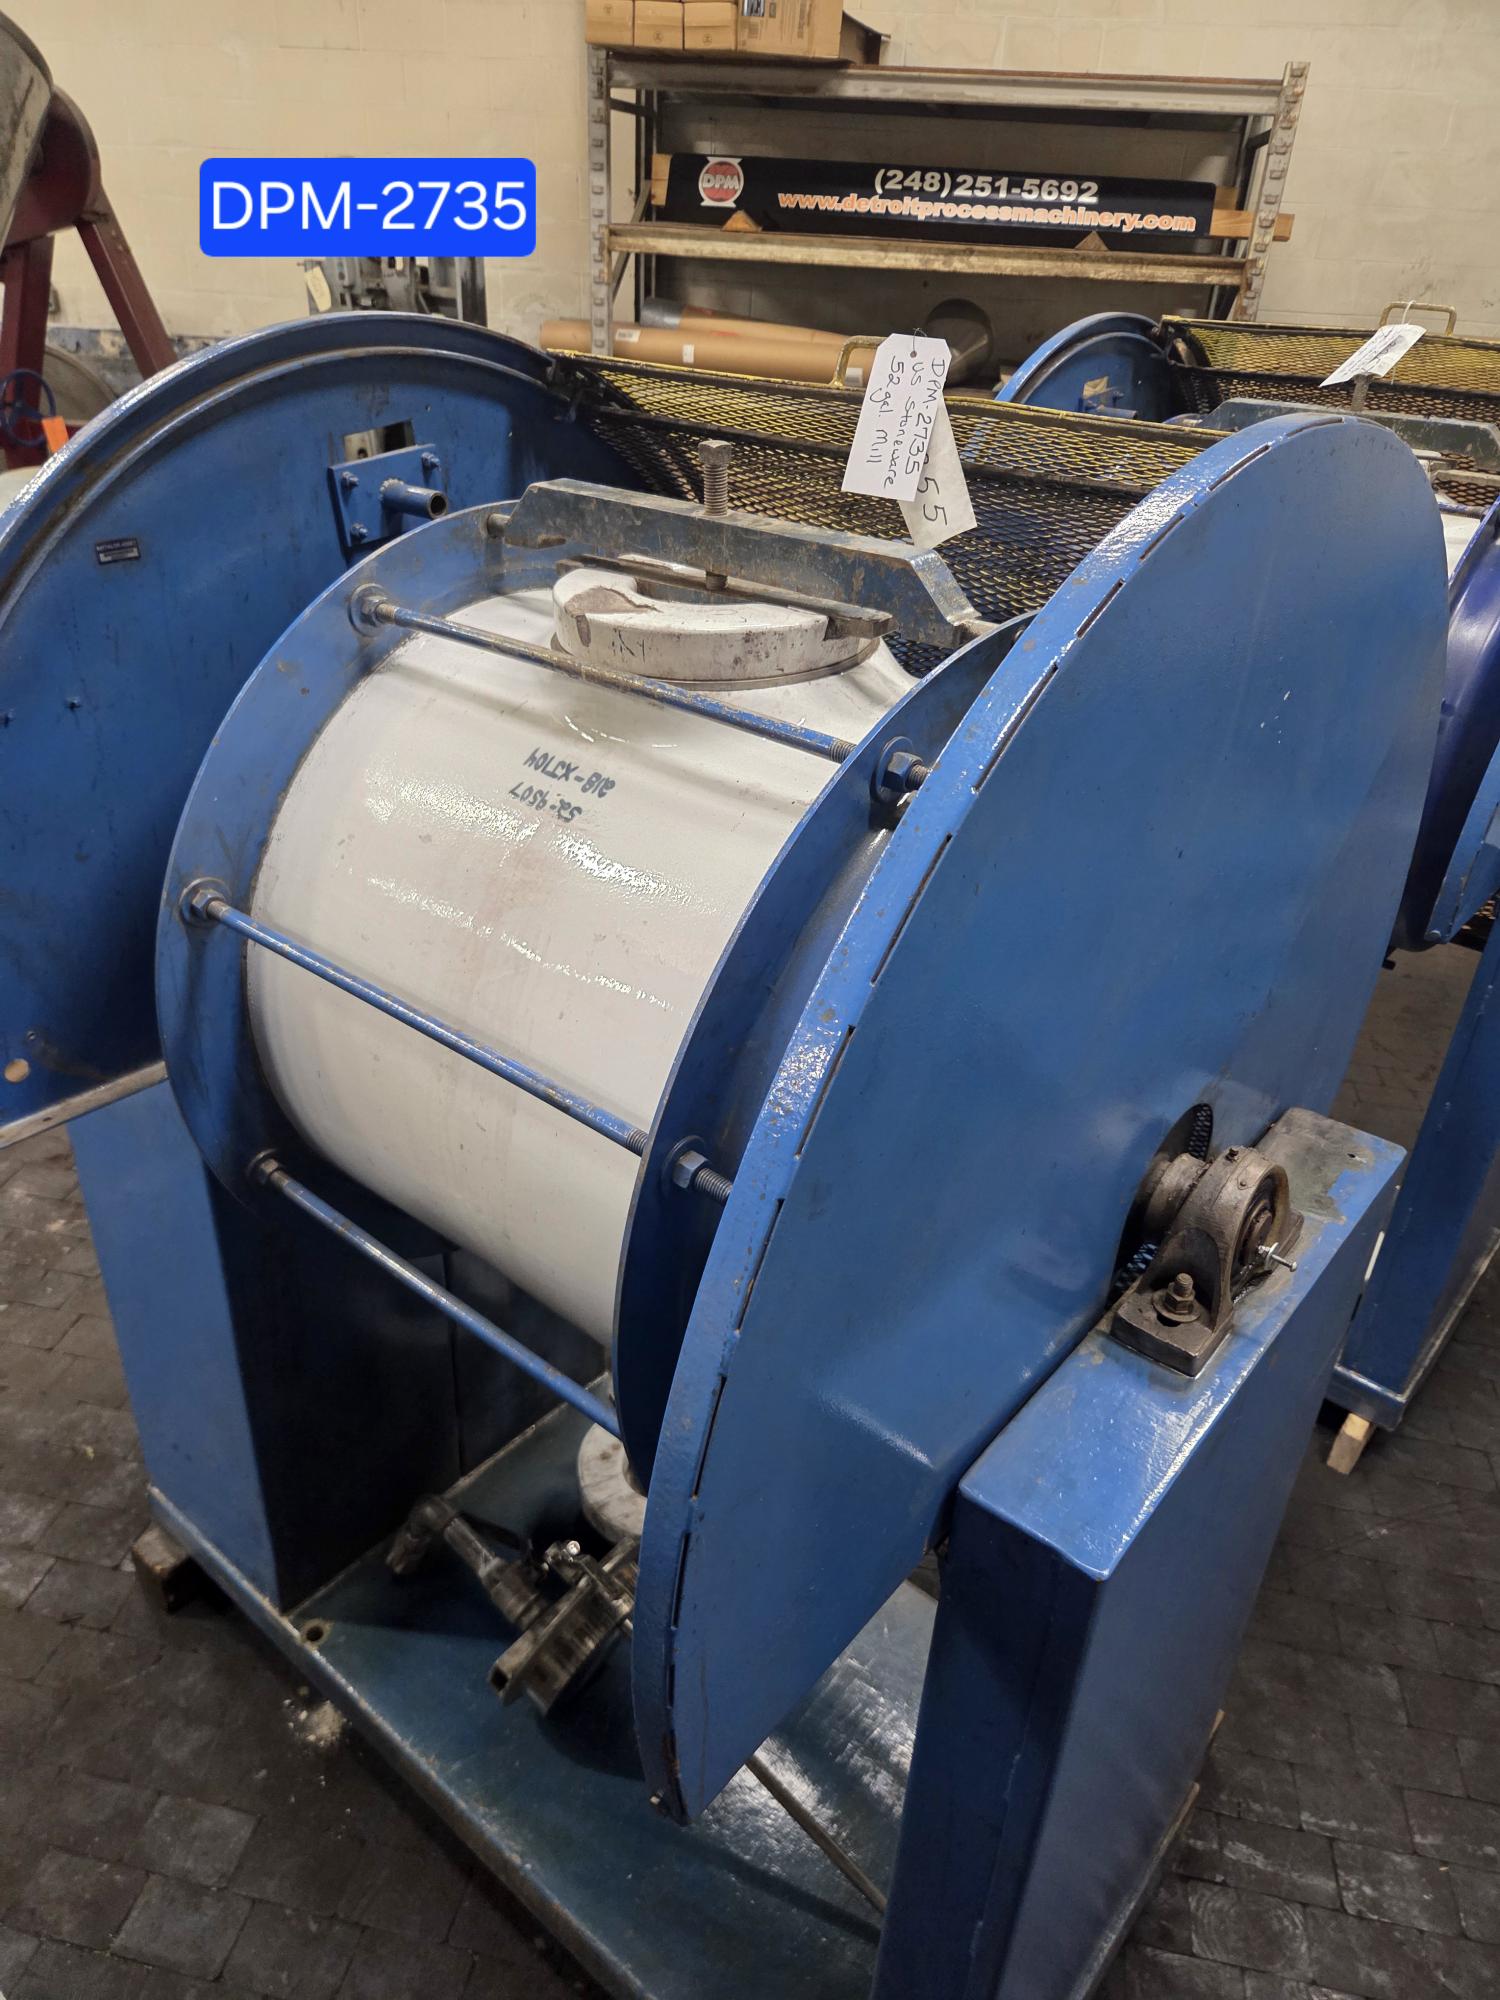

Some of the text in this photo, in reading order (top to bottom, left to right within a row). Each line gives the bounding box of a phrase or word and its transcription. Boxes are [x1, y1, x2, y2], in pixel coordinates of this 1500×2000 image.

[702, 173, 740, 190] DPM
[874, 168, 1100, 204] (248)251-5692
[777, 192, 1197, 233] www.detroitprocessmachinery.com
[886, 355, 905, 388] 52
[910, 362, 925, 387] US
[866, 429, 888, 464] Mill
